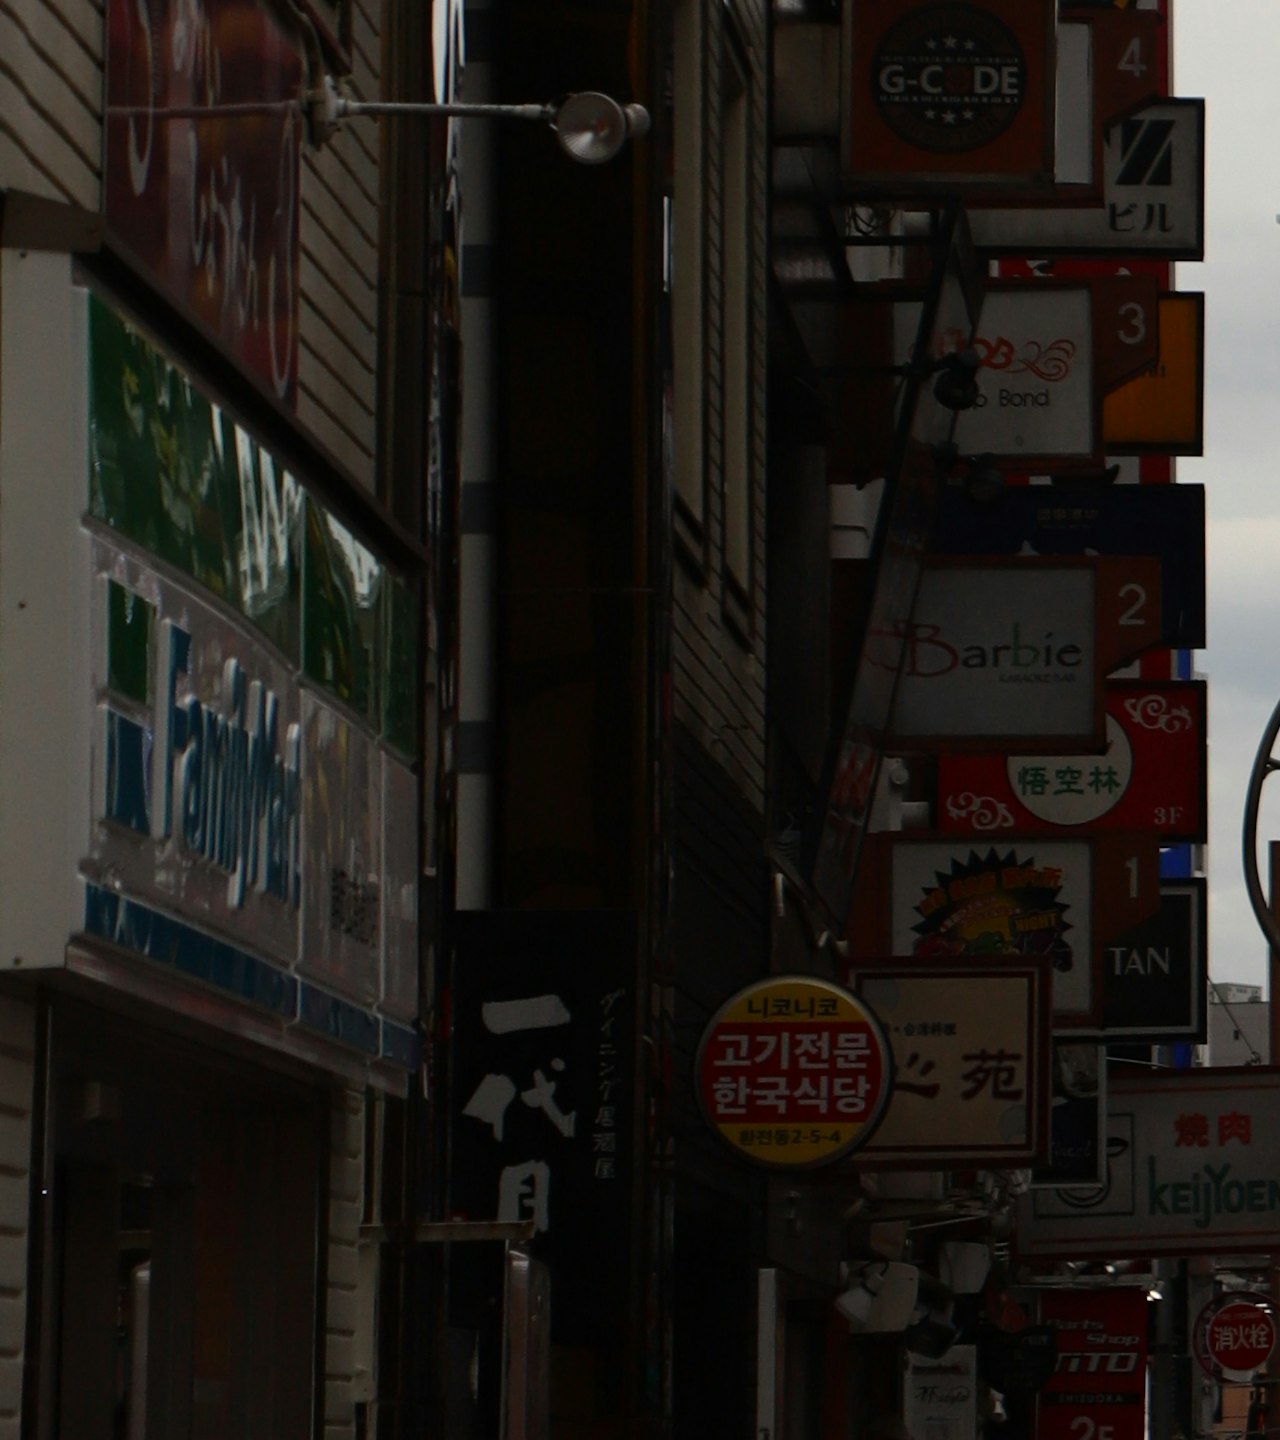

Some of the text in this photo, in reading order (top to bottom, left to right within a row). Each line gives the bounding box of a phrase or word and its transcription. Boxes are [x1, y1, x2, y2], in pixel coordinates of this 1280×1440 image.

[1117, 36, 1147, 78] 4
[1109, 201, 1175, 233] ビル
[1116, 301, 1147, 345] 3
[1116, 582, 1147, 626] 2
[906, 621, 1082, 677] Barbie
[1017, 764, 1123, 797] 悟空林
[1152, 805, 1185, 826] 3F
[1123, 855, 1139, 899] 1
[747, 996, 840, 1018] 니코니코
[712, 1030, 872, 1070] 고기전문
[711, 1073, 872, 1115] 한국식당
[1174, 1110, 1252, 1147] 焼肉
[1085, 1332, 1140, 1346] Shop
[1213, 1323, 1271, 1352] 消火栓
